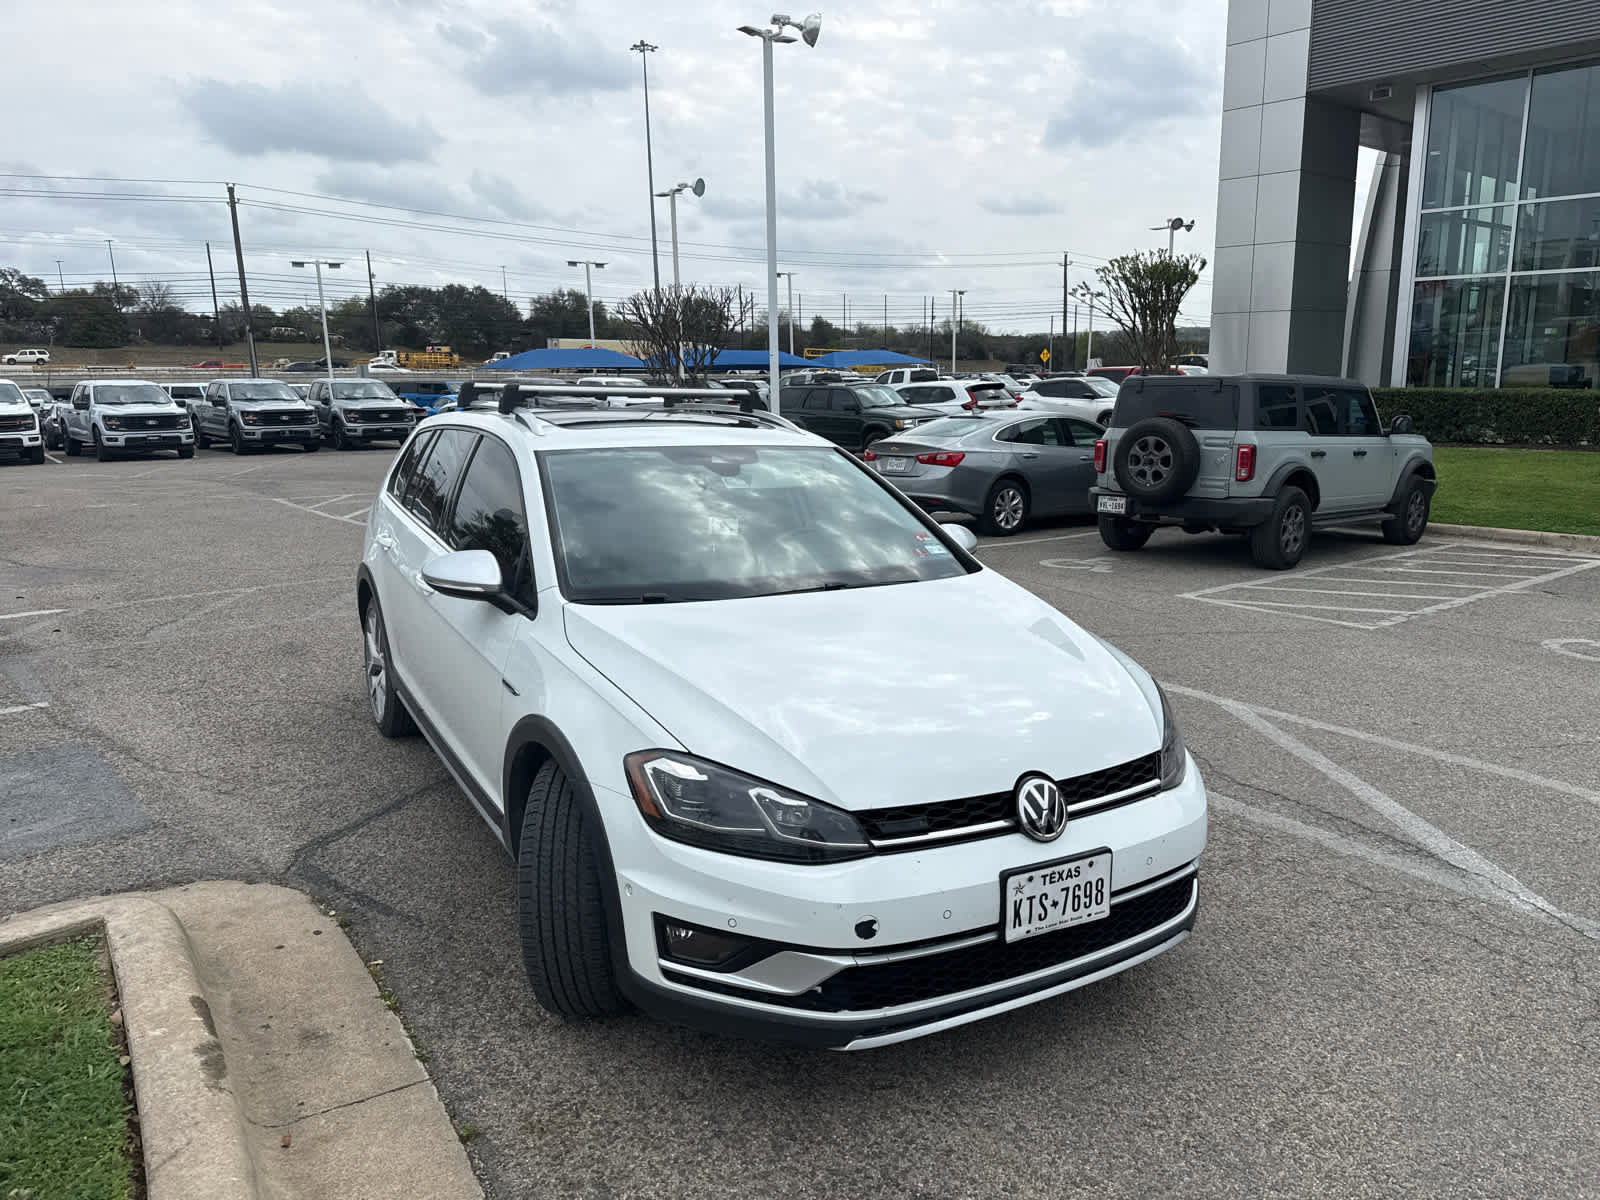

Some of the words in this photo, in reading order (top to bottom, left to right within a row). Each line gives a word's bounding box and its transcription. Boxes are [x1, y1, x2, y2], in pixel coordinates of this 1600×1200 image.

[1041, 866, 1081, 886] TEXAS
[1013, 892, 1049, 929] KTS
[1060, 877, 1104, 916] 7698
